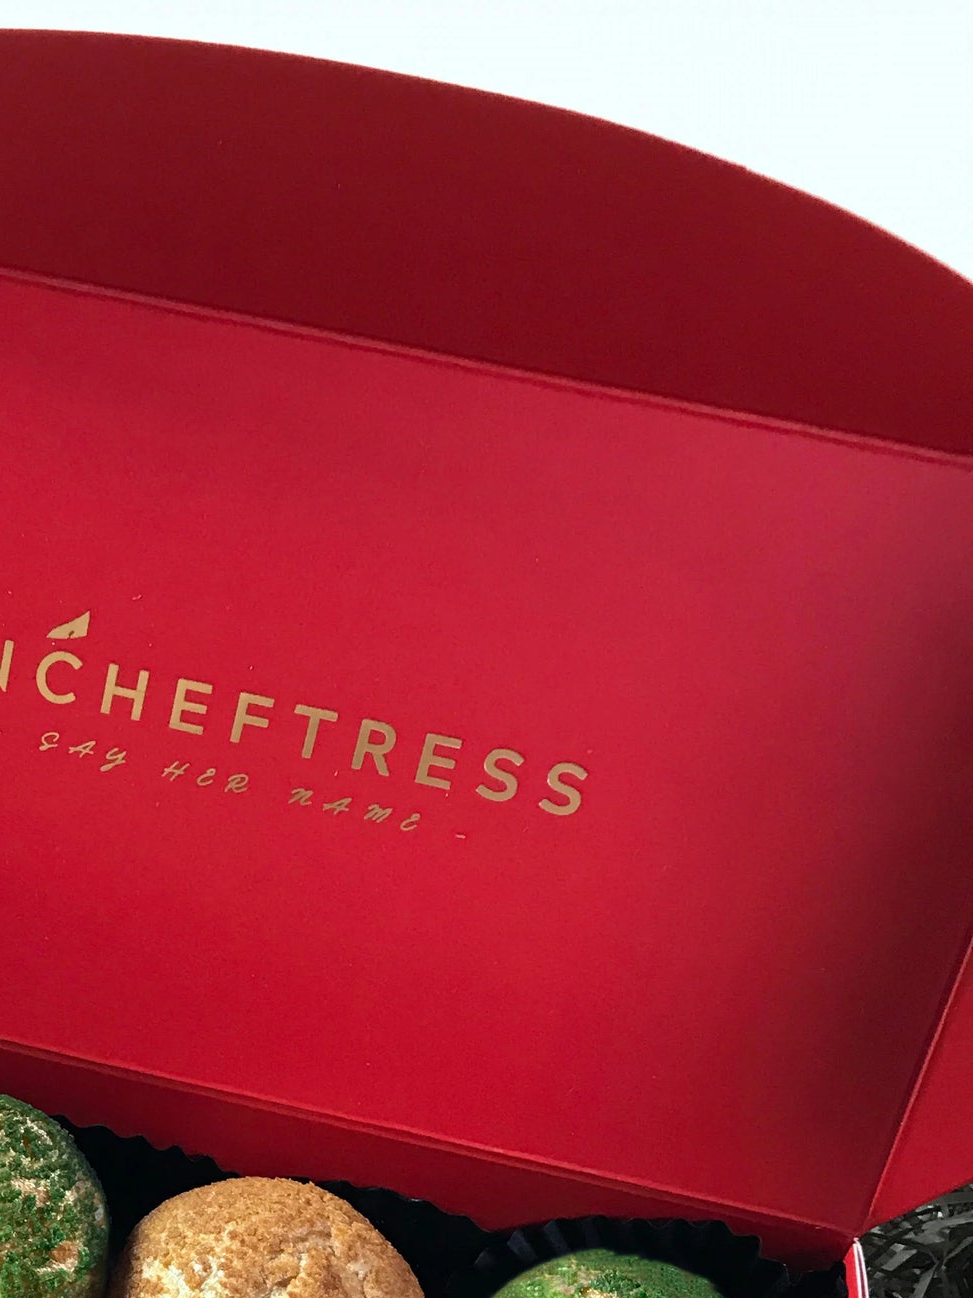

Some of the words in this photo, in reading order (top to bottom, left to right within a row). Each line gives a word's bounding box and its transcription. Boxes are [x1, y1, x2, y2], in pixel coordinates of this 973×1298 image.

[38, 730, 128, 770] SAY
[162, 758, 251, 795] HER
[289, 787, 423, 832] NAME
